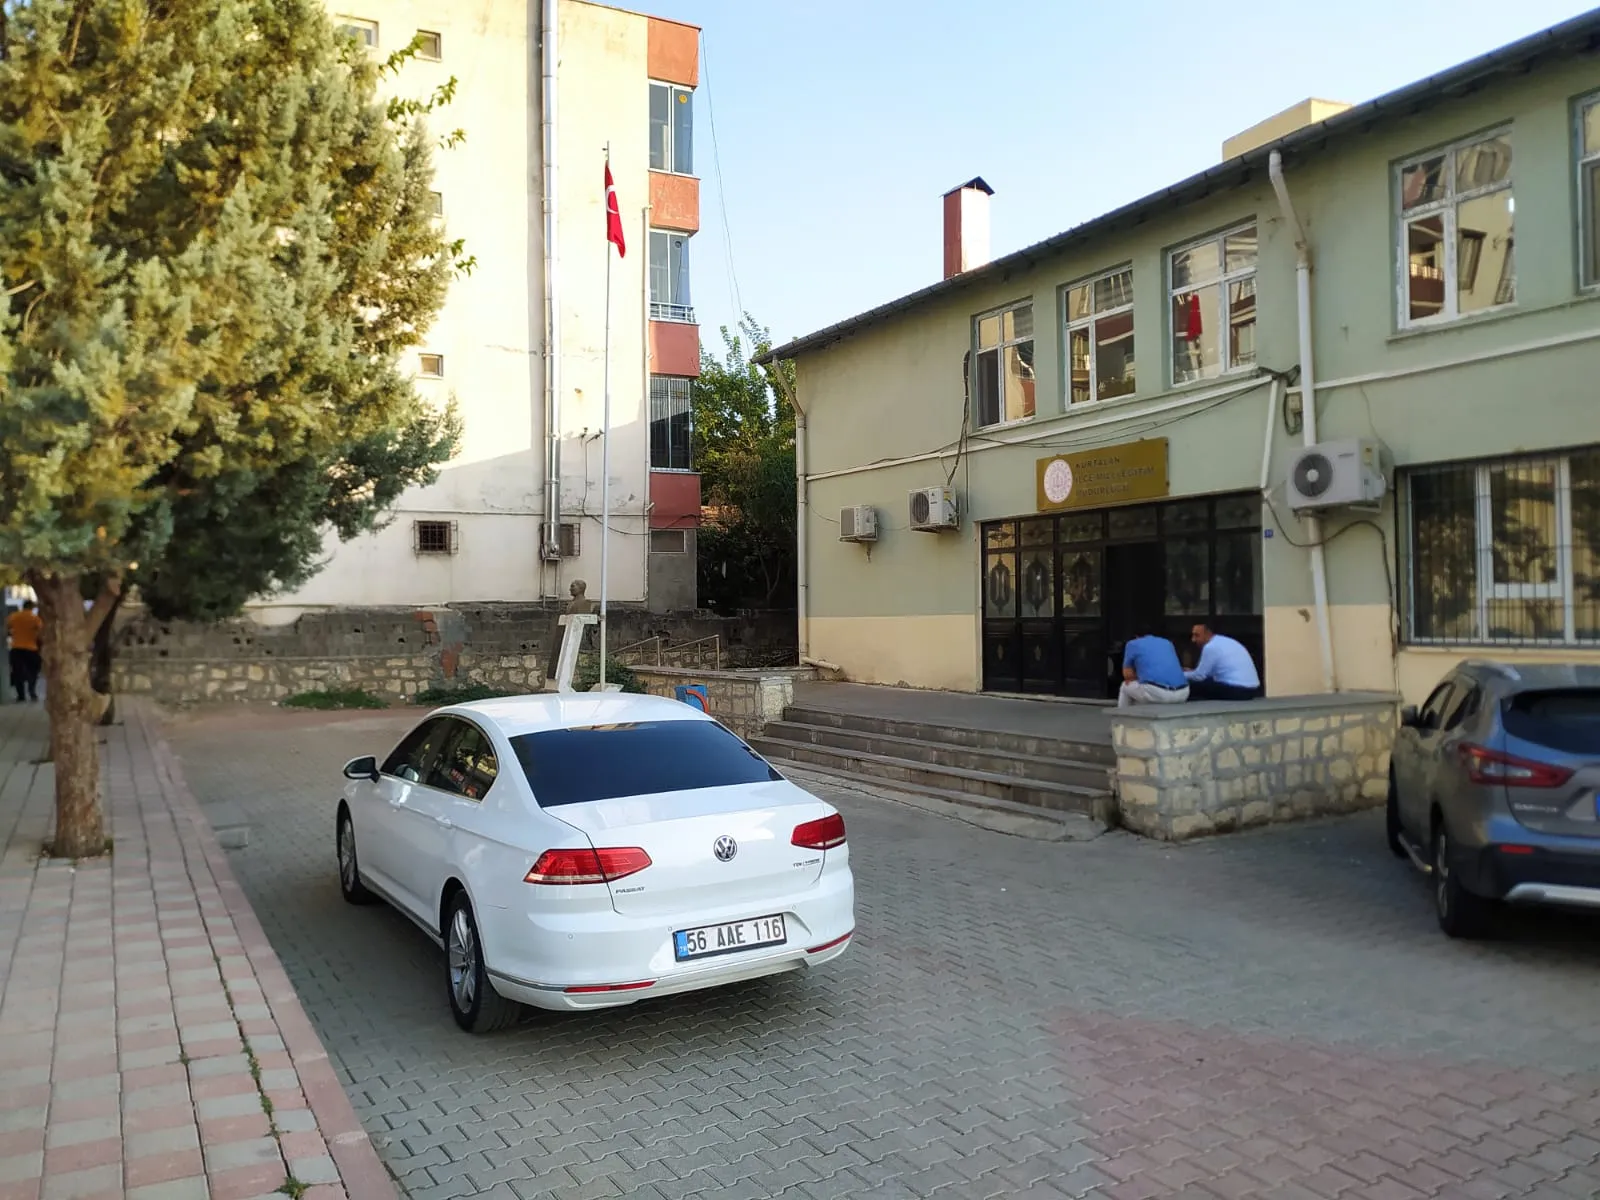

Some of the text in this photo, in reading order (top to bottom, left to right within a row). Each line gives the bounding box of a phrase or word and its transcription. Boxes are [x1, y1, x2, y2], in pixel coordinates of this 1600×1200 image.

[687, 931, 707, 952] 56
[717, 924, 746, 947] AAE
[753, 919, 782, 941] 116
